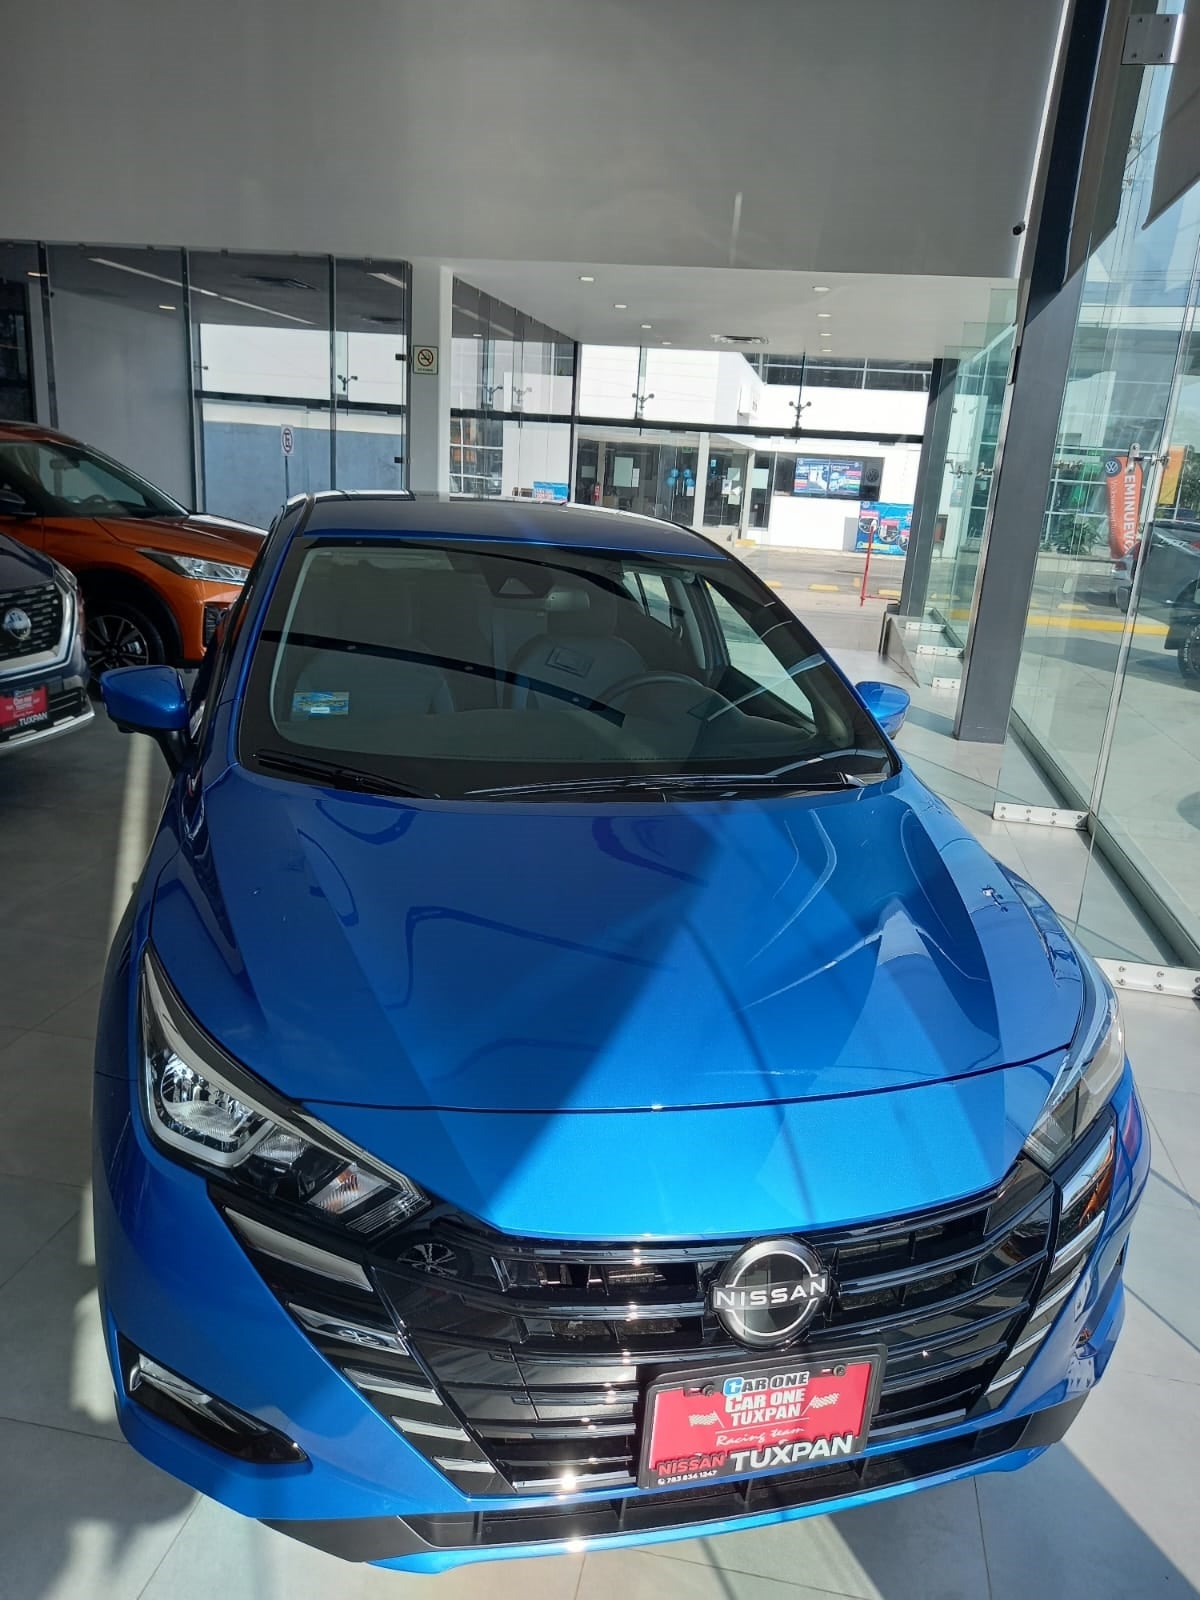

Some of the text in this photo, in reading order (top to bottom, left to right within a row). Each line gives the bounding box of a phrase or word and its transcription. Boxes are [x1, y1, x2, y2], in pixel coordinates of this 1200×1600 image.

[19, 711, 48, 726] TUXPAN
[716, 1278, 826, 1307] NISSAN
[723, 1371, 809, 1396] CAR ONE
[725, 1388, 806, 1413] CAR ONE
[731, 1403, 801, 1426] TUXPAN
[715, 1427, 805, 1447] Racing team
[657, 1434, 853, 1476] NISSAN TUXPAN
